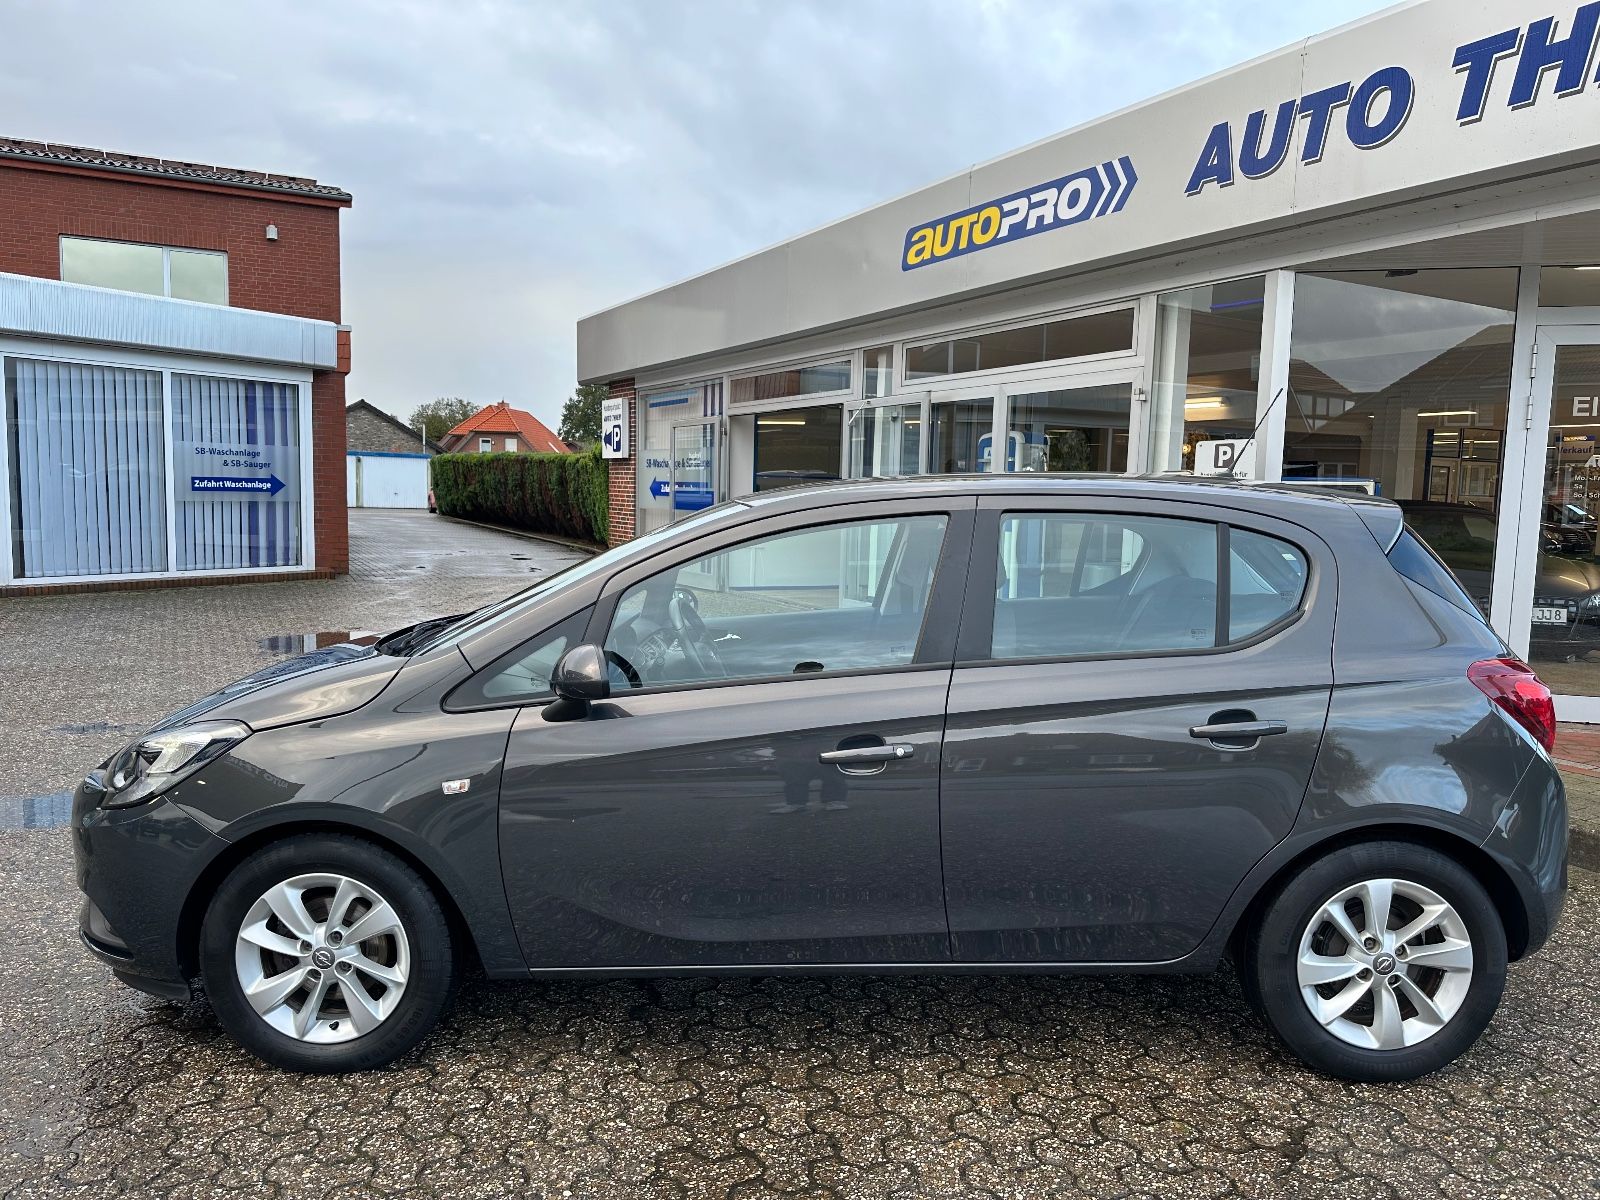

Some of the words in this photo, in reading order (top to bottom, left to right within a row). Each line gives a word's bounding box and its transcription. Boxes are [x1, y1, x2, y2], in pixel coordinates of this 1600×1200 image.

[1184, 66, 1414, 197] AUTO
[1451, 0, 1600, 127] TH
[614, 428, 621, 449] P
[195, 447, 260, 458] SB-Waschanlage
[1218, 446, 1231, 466] P
[231, 460, 271, 470] SB-Sauger
[194, 480, 223, 488] Zufahrt
[224, 481, 272, 489] Waschanlage
[1555, 609, 1561, 620] 8
